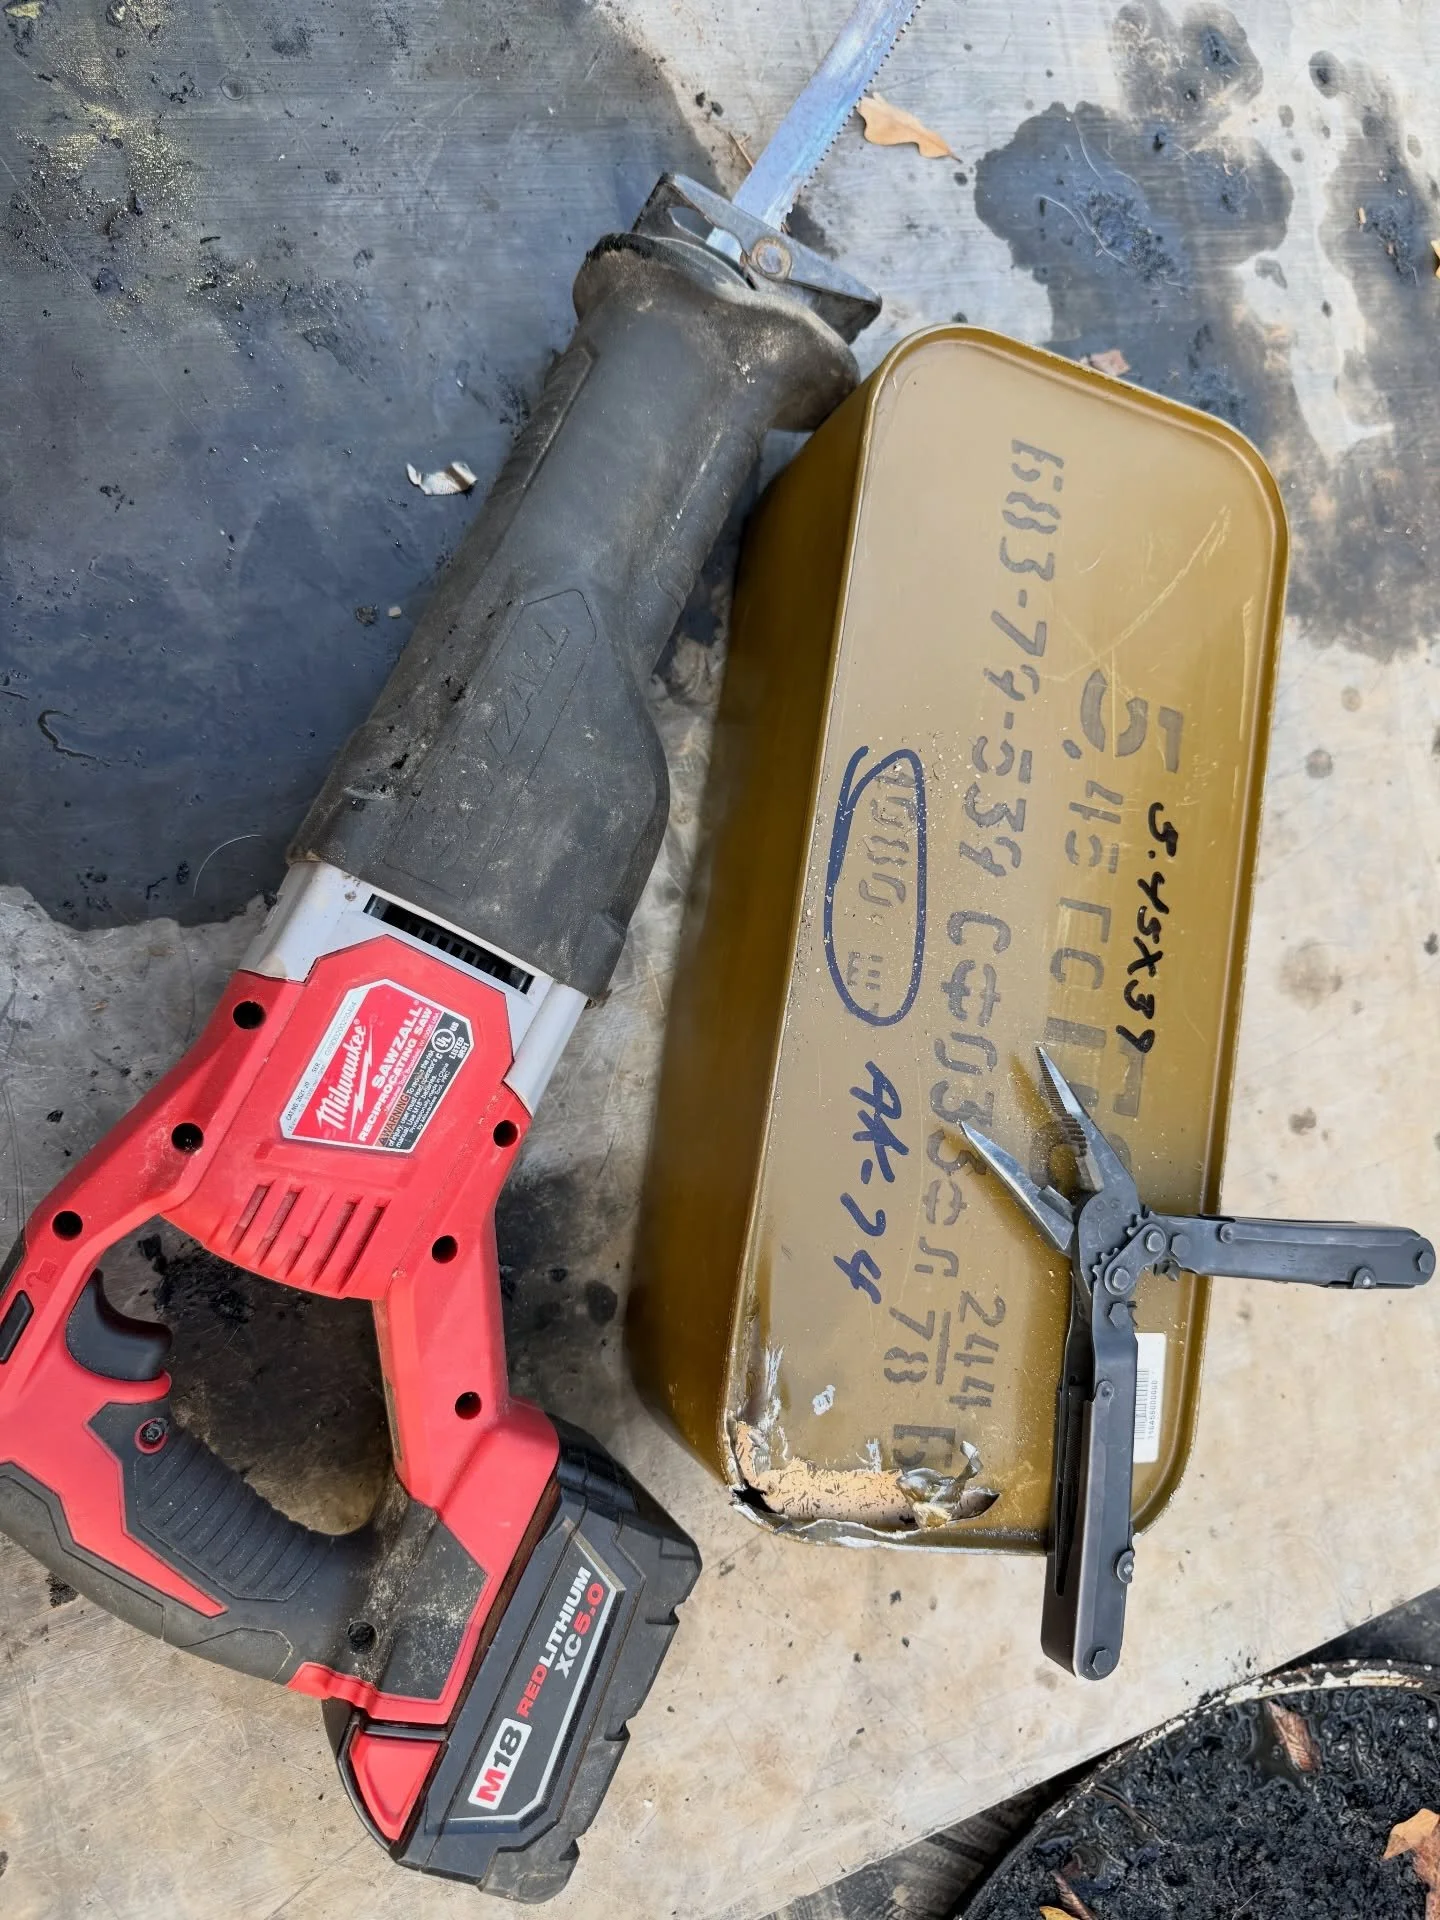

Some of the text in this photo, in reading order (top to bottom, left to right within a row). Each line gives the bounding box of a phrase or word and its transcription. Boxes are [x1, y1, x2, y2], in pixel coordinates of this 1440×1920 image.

[315, 1024, 367, 1129] Milwaukee
[357, 1007, 432, 1141] RECIPROCATING SAW
[372, 1006, 422, 1088] SAWZALL
[449, 1036, 465, 1059] LISTED
[382, 1094, 410, 1137] WARNING
[555, 1582, 604, 1679] XC5.0
[476, 1726, 522, 1802] M18
